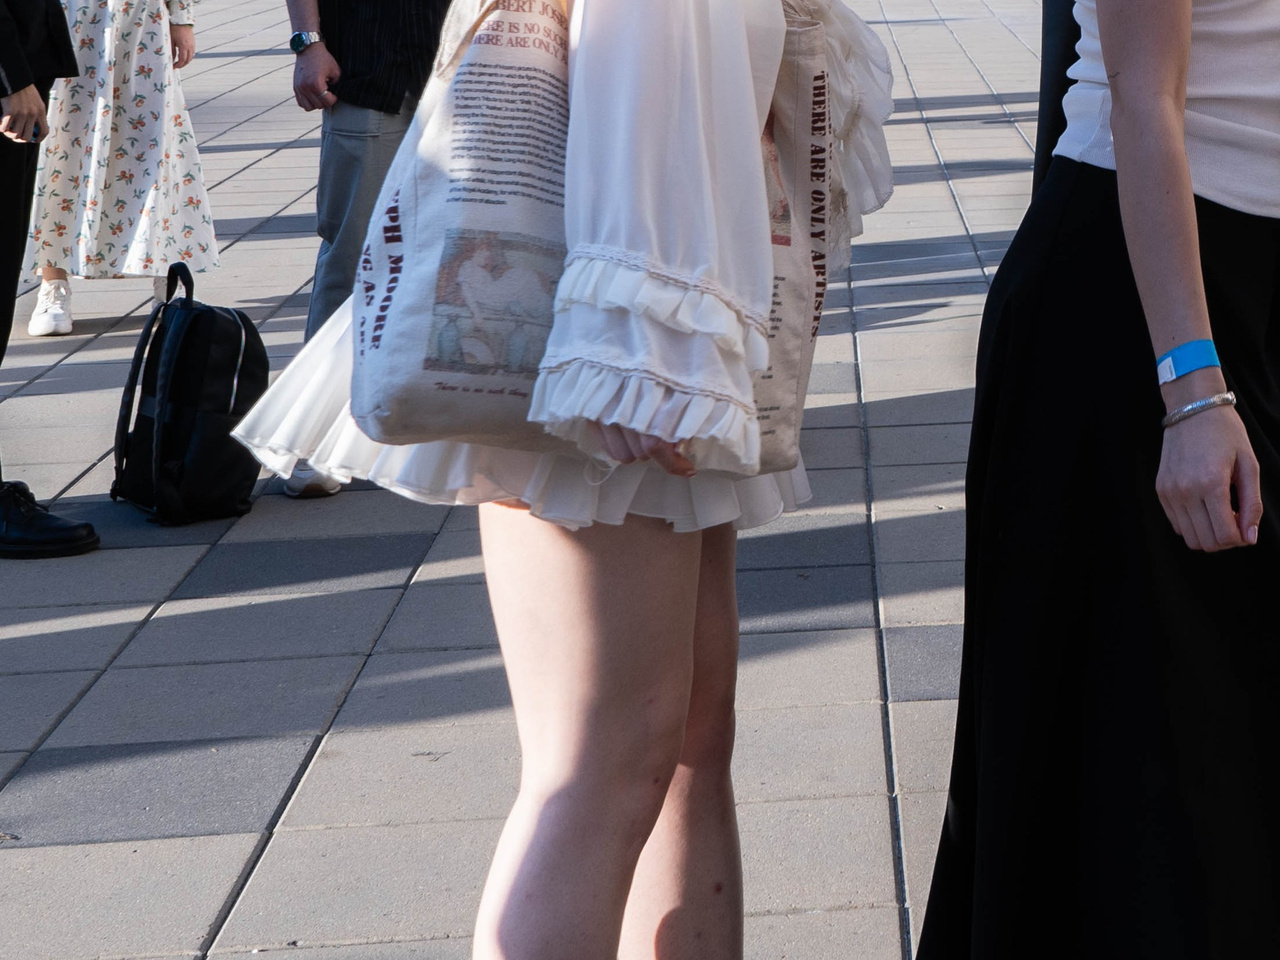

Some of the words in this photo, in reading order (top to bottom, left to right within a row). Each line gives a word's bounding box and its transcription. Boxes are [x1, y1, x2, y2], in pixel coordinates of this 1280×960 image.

[480, 19, 504, 33] ERE
[508, 22, 520, 33] IS
[523, 22, 541, 34] NO
[504, 36, 530, 48] ARE
[532, 38, 560, 58] ONLY
[811, 71, 827, 137] THERE
[810, 143, 826, 183] ARE
[810, 190, 826, 243] ONLY
